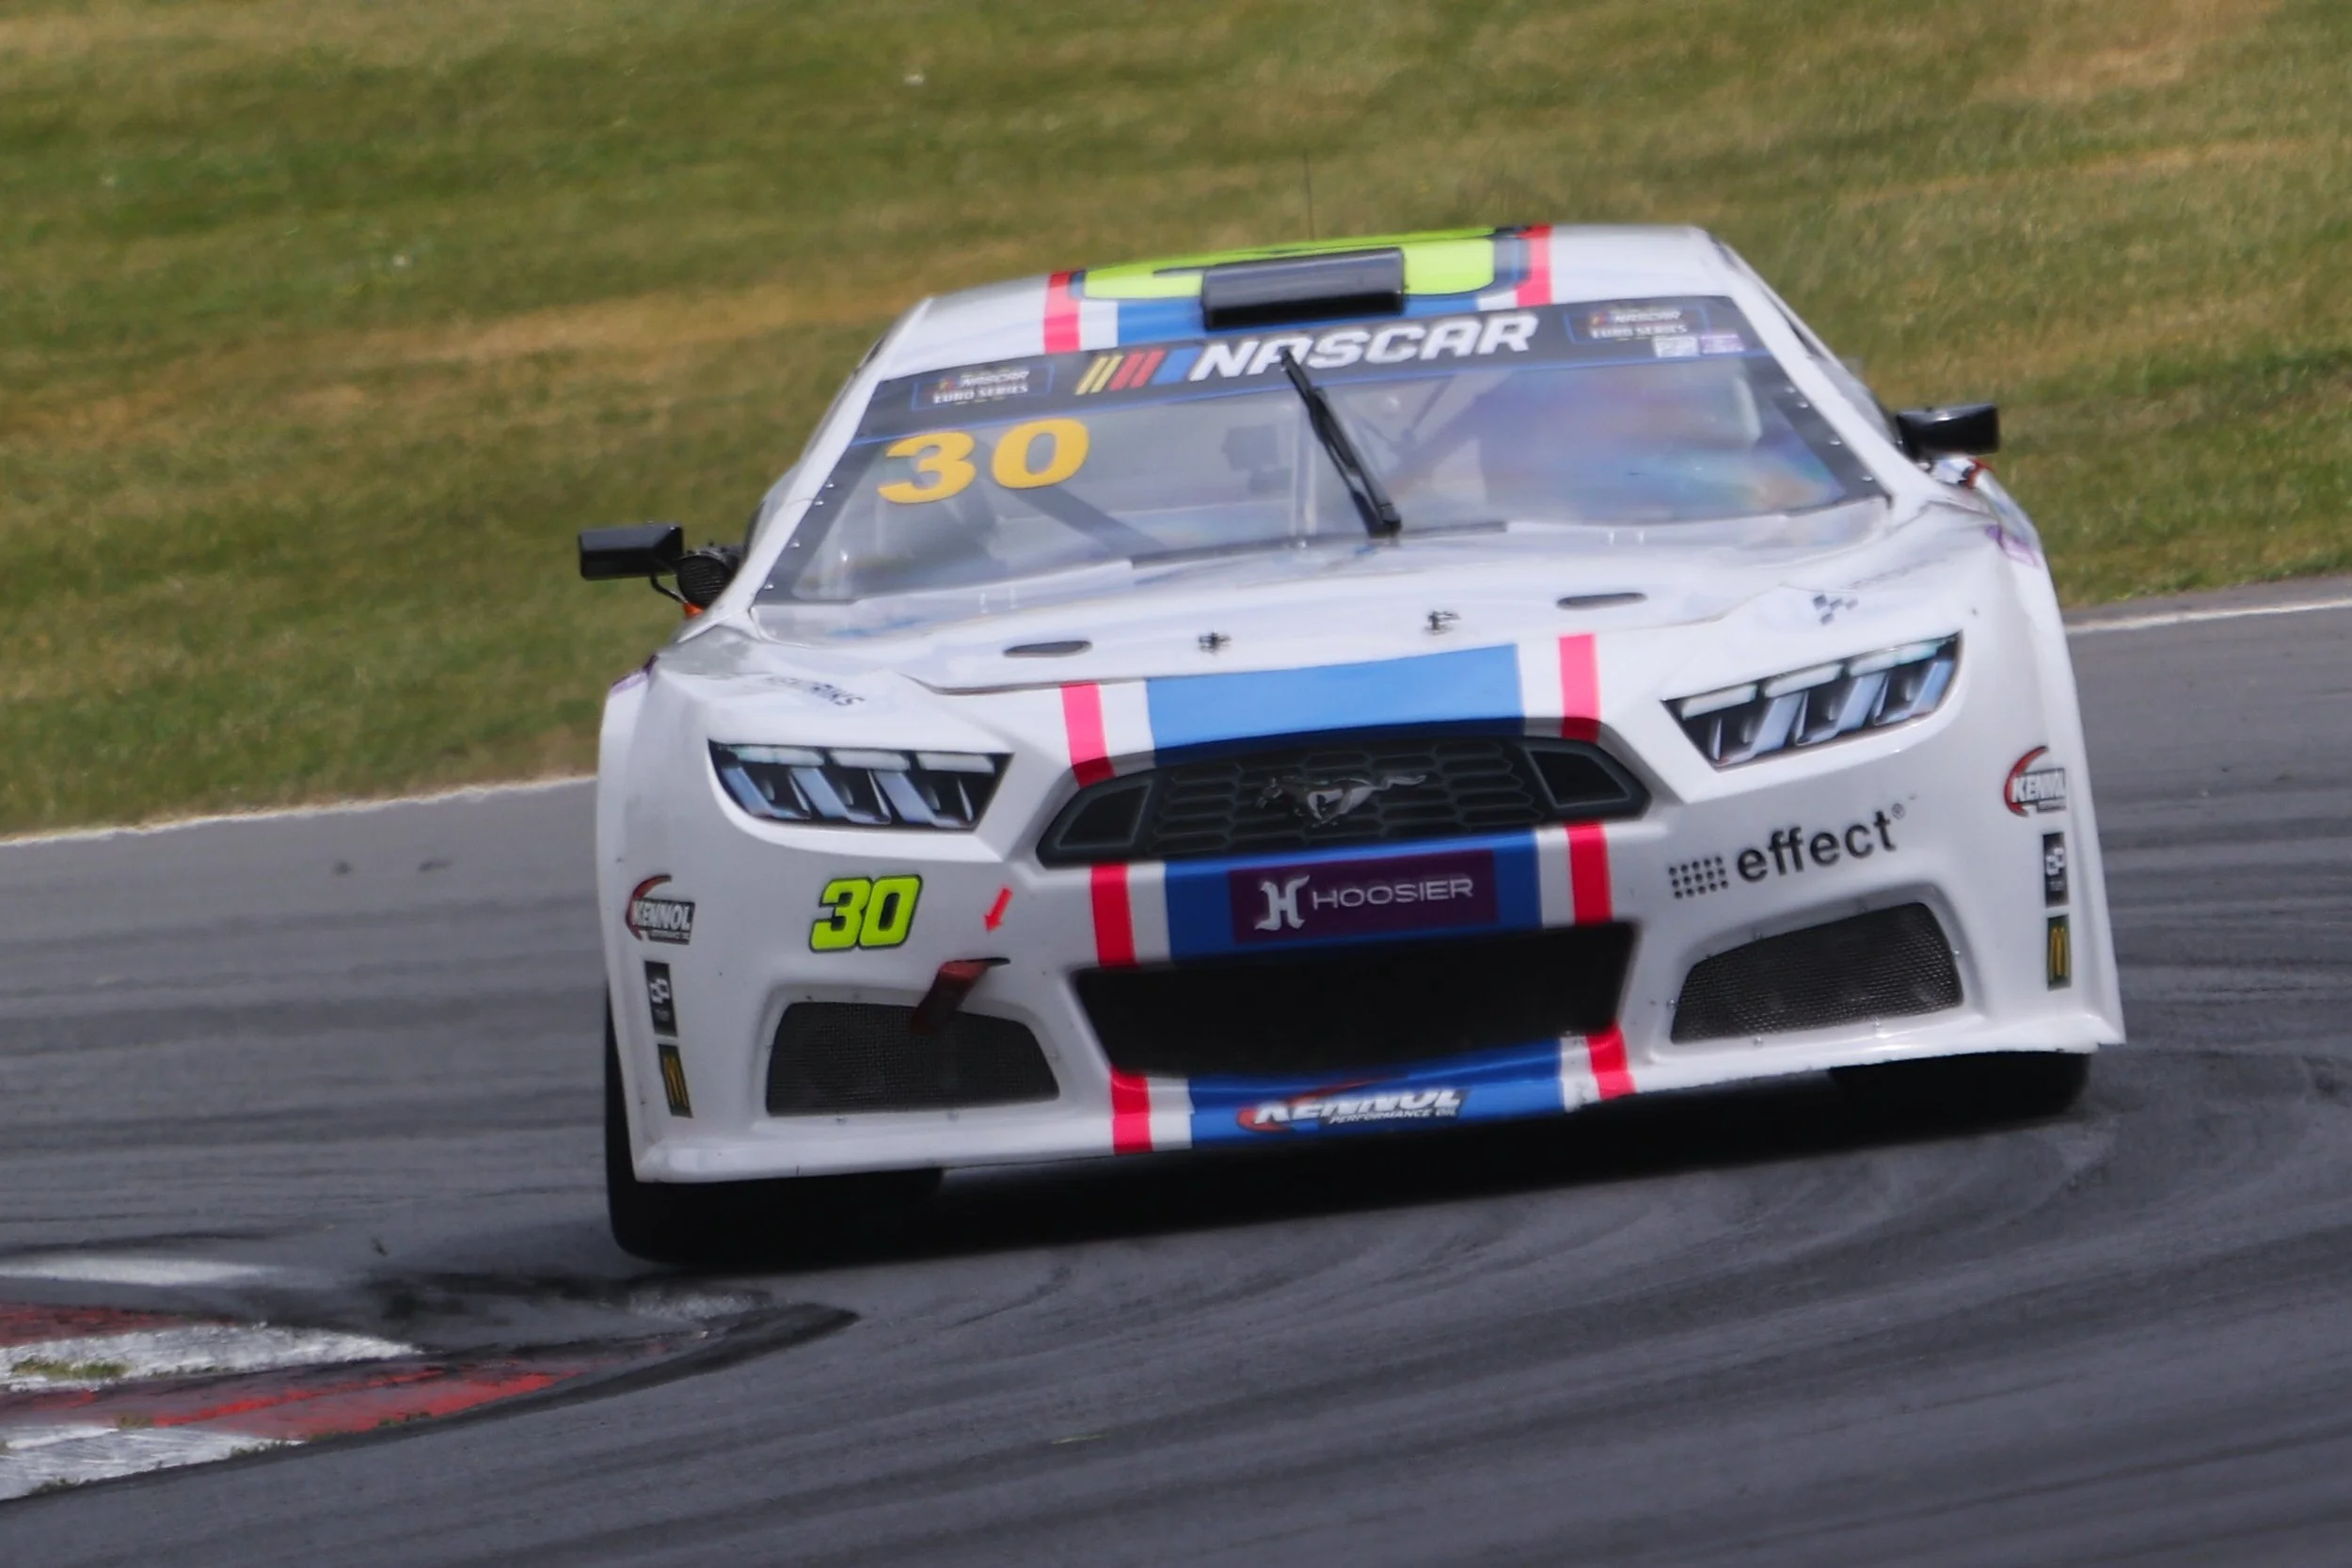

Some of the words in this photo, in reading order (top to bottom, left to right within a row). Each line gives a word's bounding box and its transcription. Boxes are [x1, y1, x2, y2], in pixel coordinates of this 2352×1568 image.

[1189, 311, 1538, 382] NASCAR
[877, 418, 1090, 504] 30
[809, 874, 922, 953] 30
[1312, 878, 1474, 910] HOOSIER
[1328, 1107, 1434, 1125] PERFORMANCE
